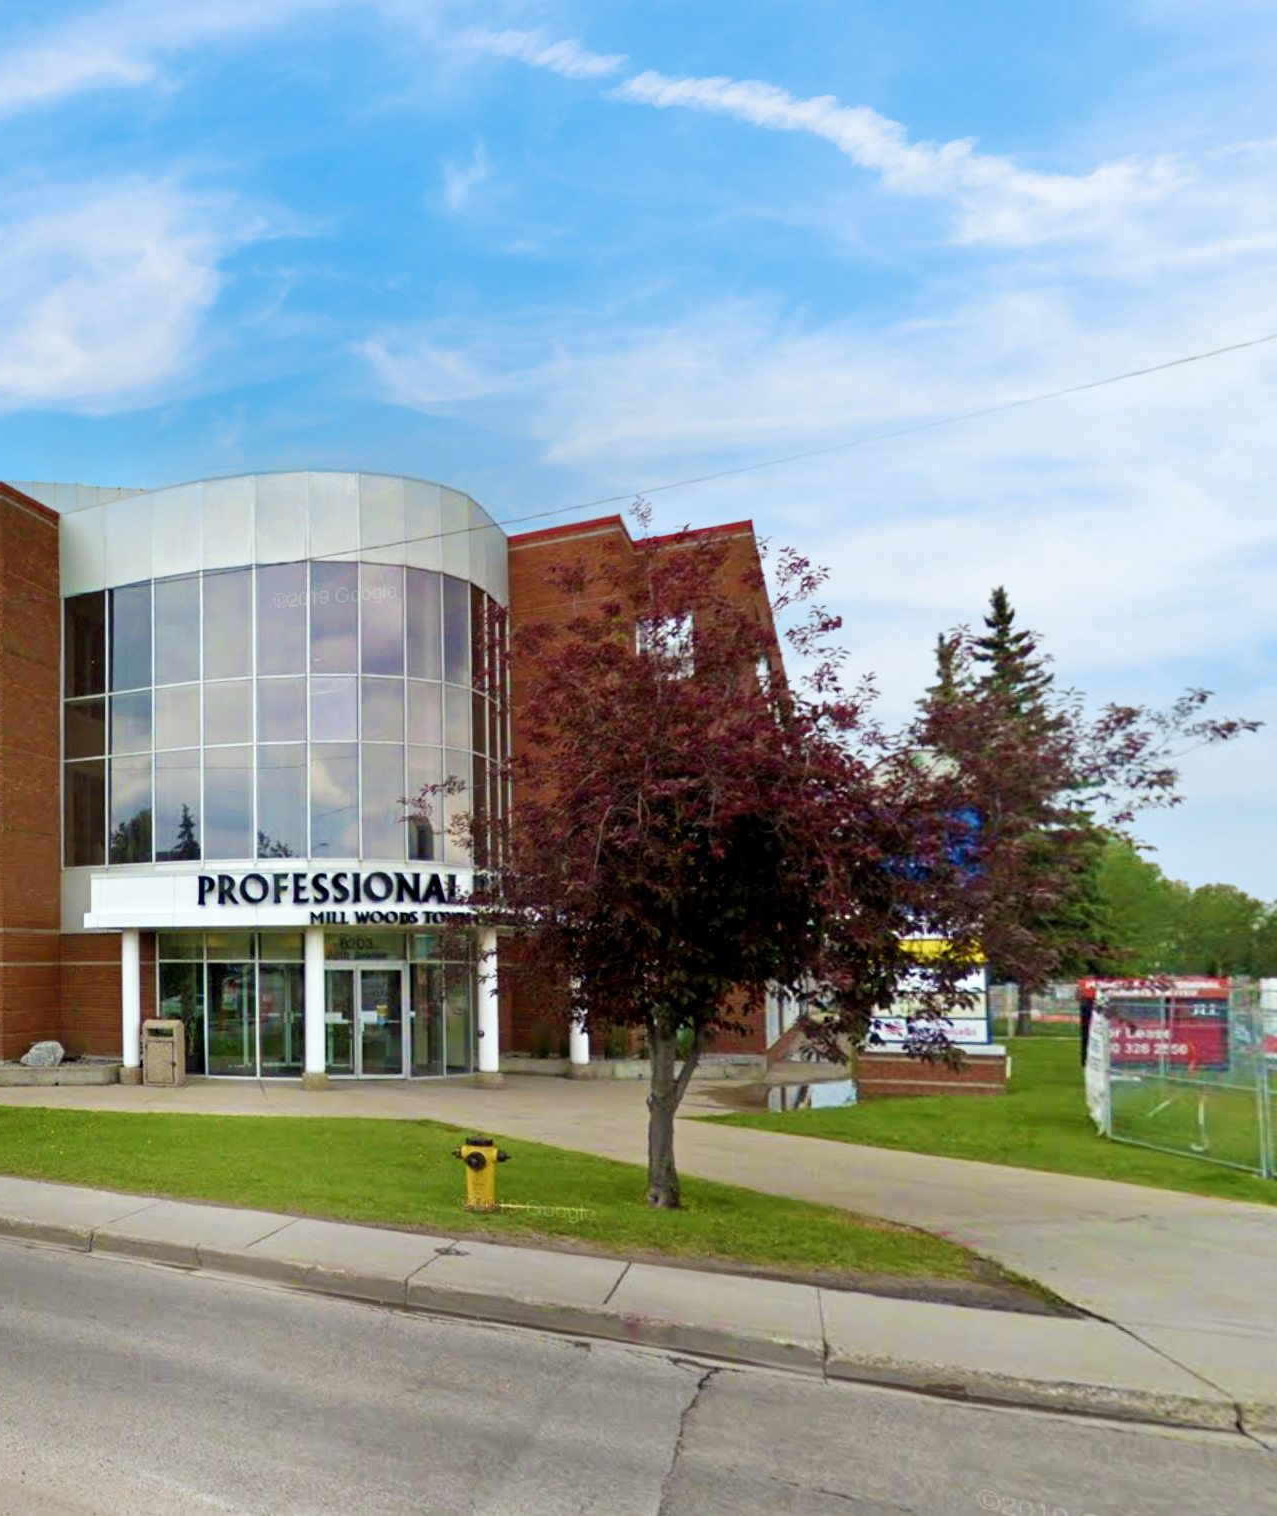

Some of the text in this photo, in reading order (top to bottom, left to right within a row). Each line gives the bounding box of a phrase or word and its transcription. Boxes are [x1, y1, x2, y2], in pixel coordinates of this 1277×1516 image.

[198, 871, 459, 906] PROFESSIONAL
[309, 911, 349, 925] MILL
[355, 910, 419, 925] WOODS
